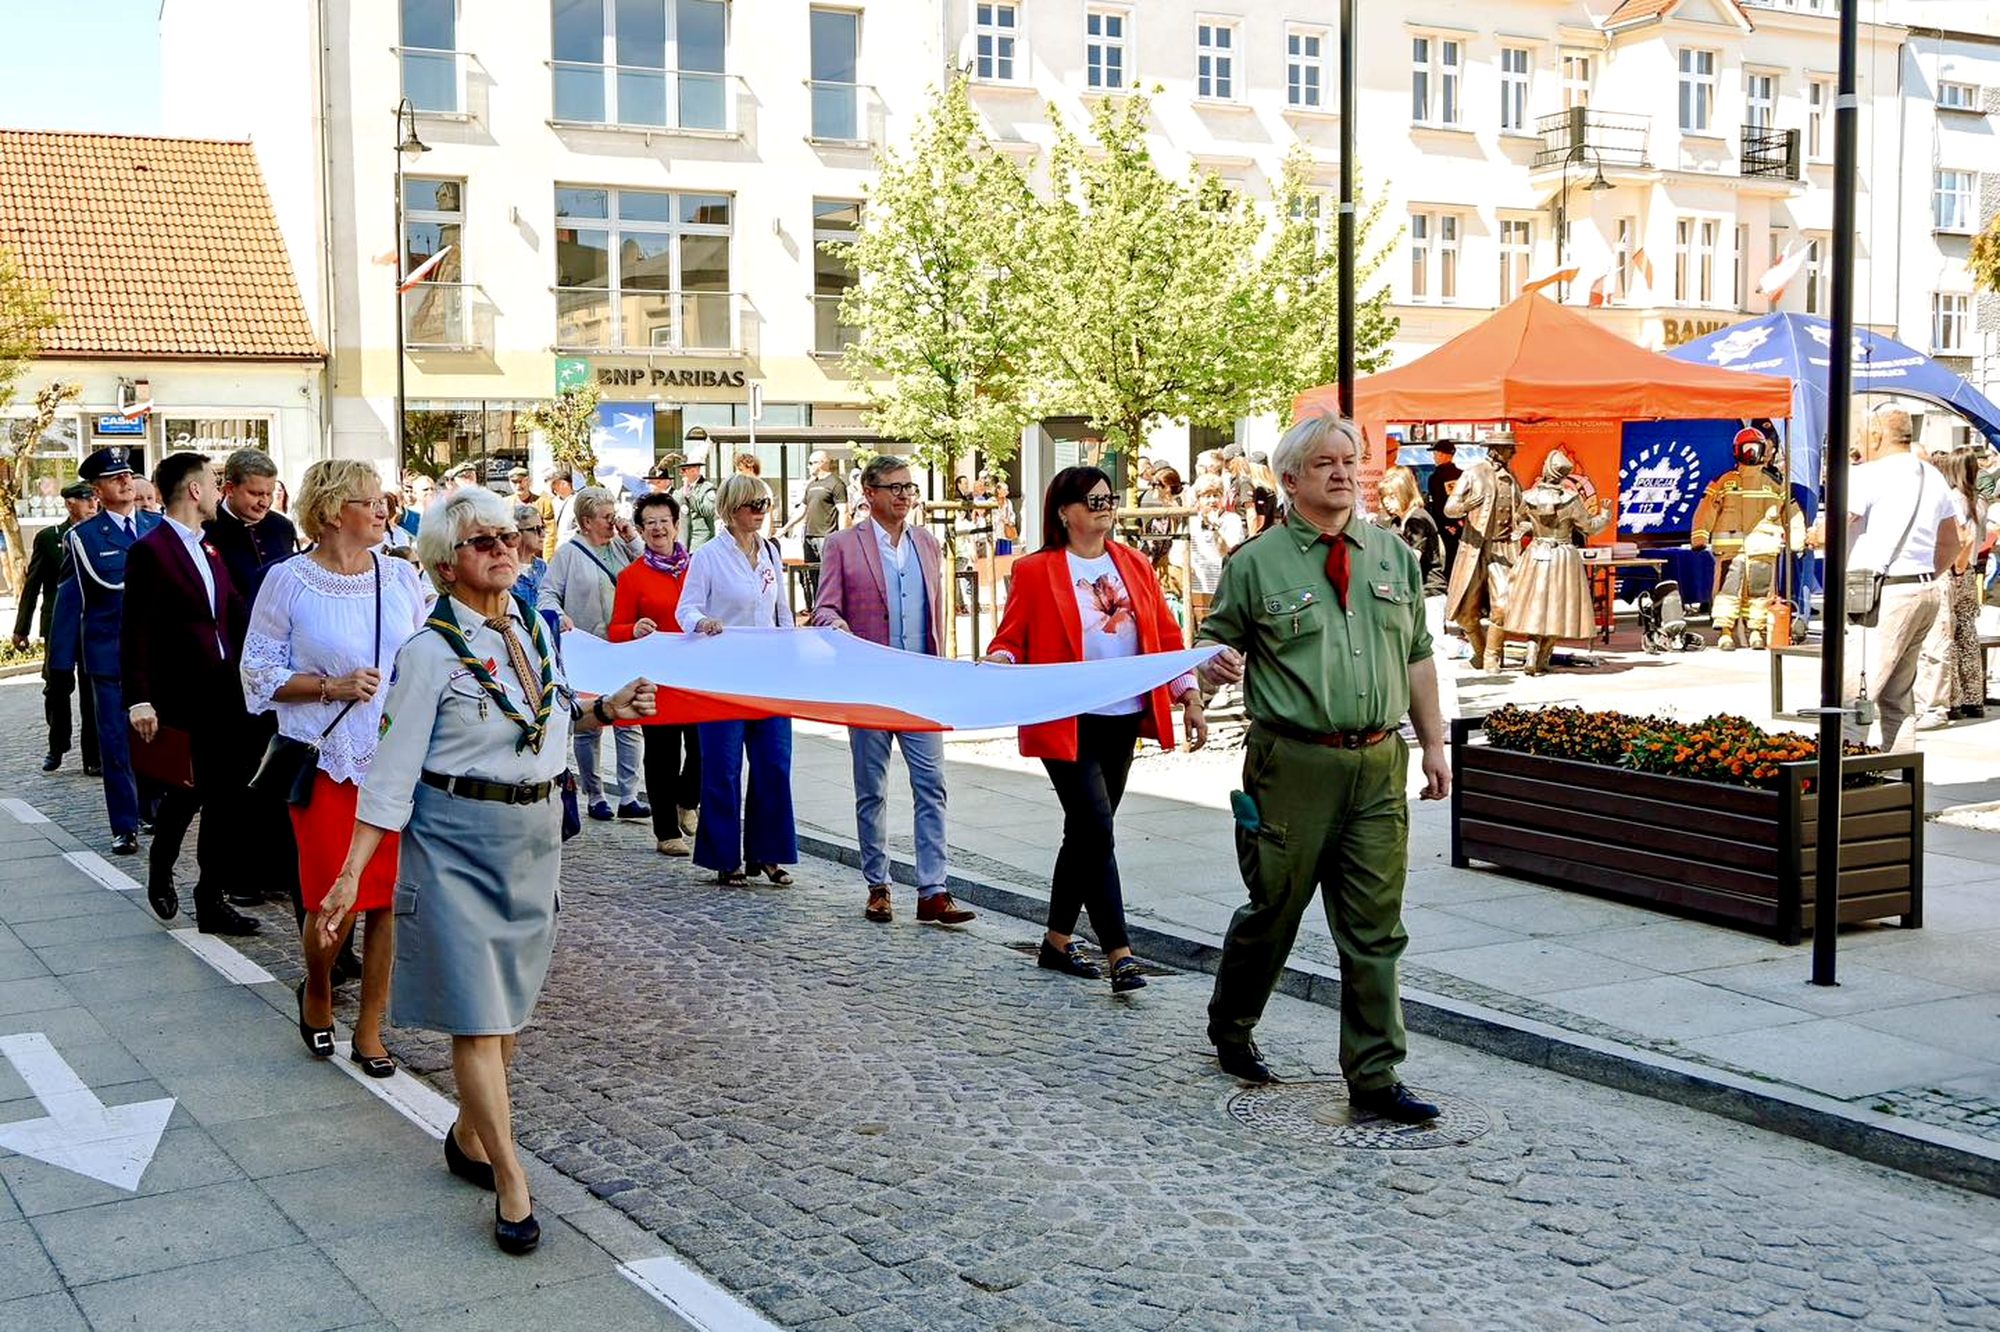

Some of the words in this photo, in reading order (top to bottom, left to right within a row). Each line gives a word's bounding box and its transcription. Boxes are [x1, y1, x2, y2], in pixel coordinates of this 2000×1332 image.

[597, 368, 645, 386] BNP
[650, 369, 745, 388] PARIBAS
[1636, 478, 1676, 488] POLICJA
[1638, 503, 1655, 514] 112
